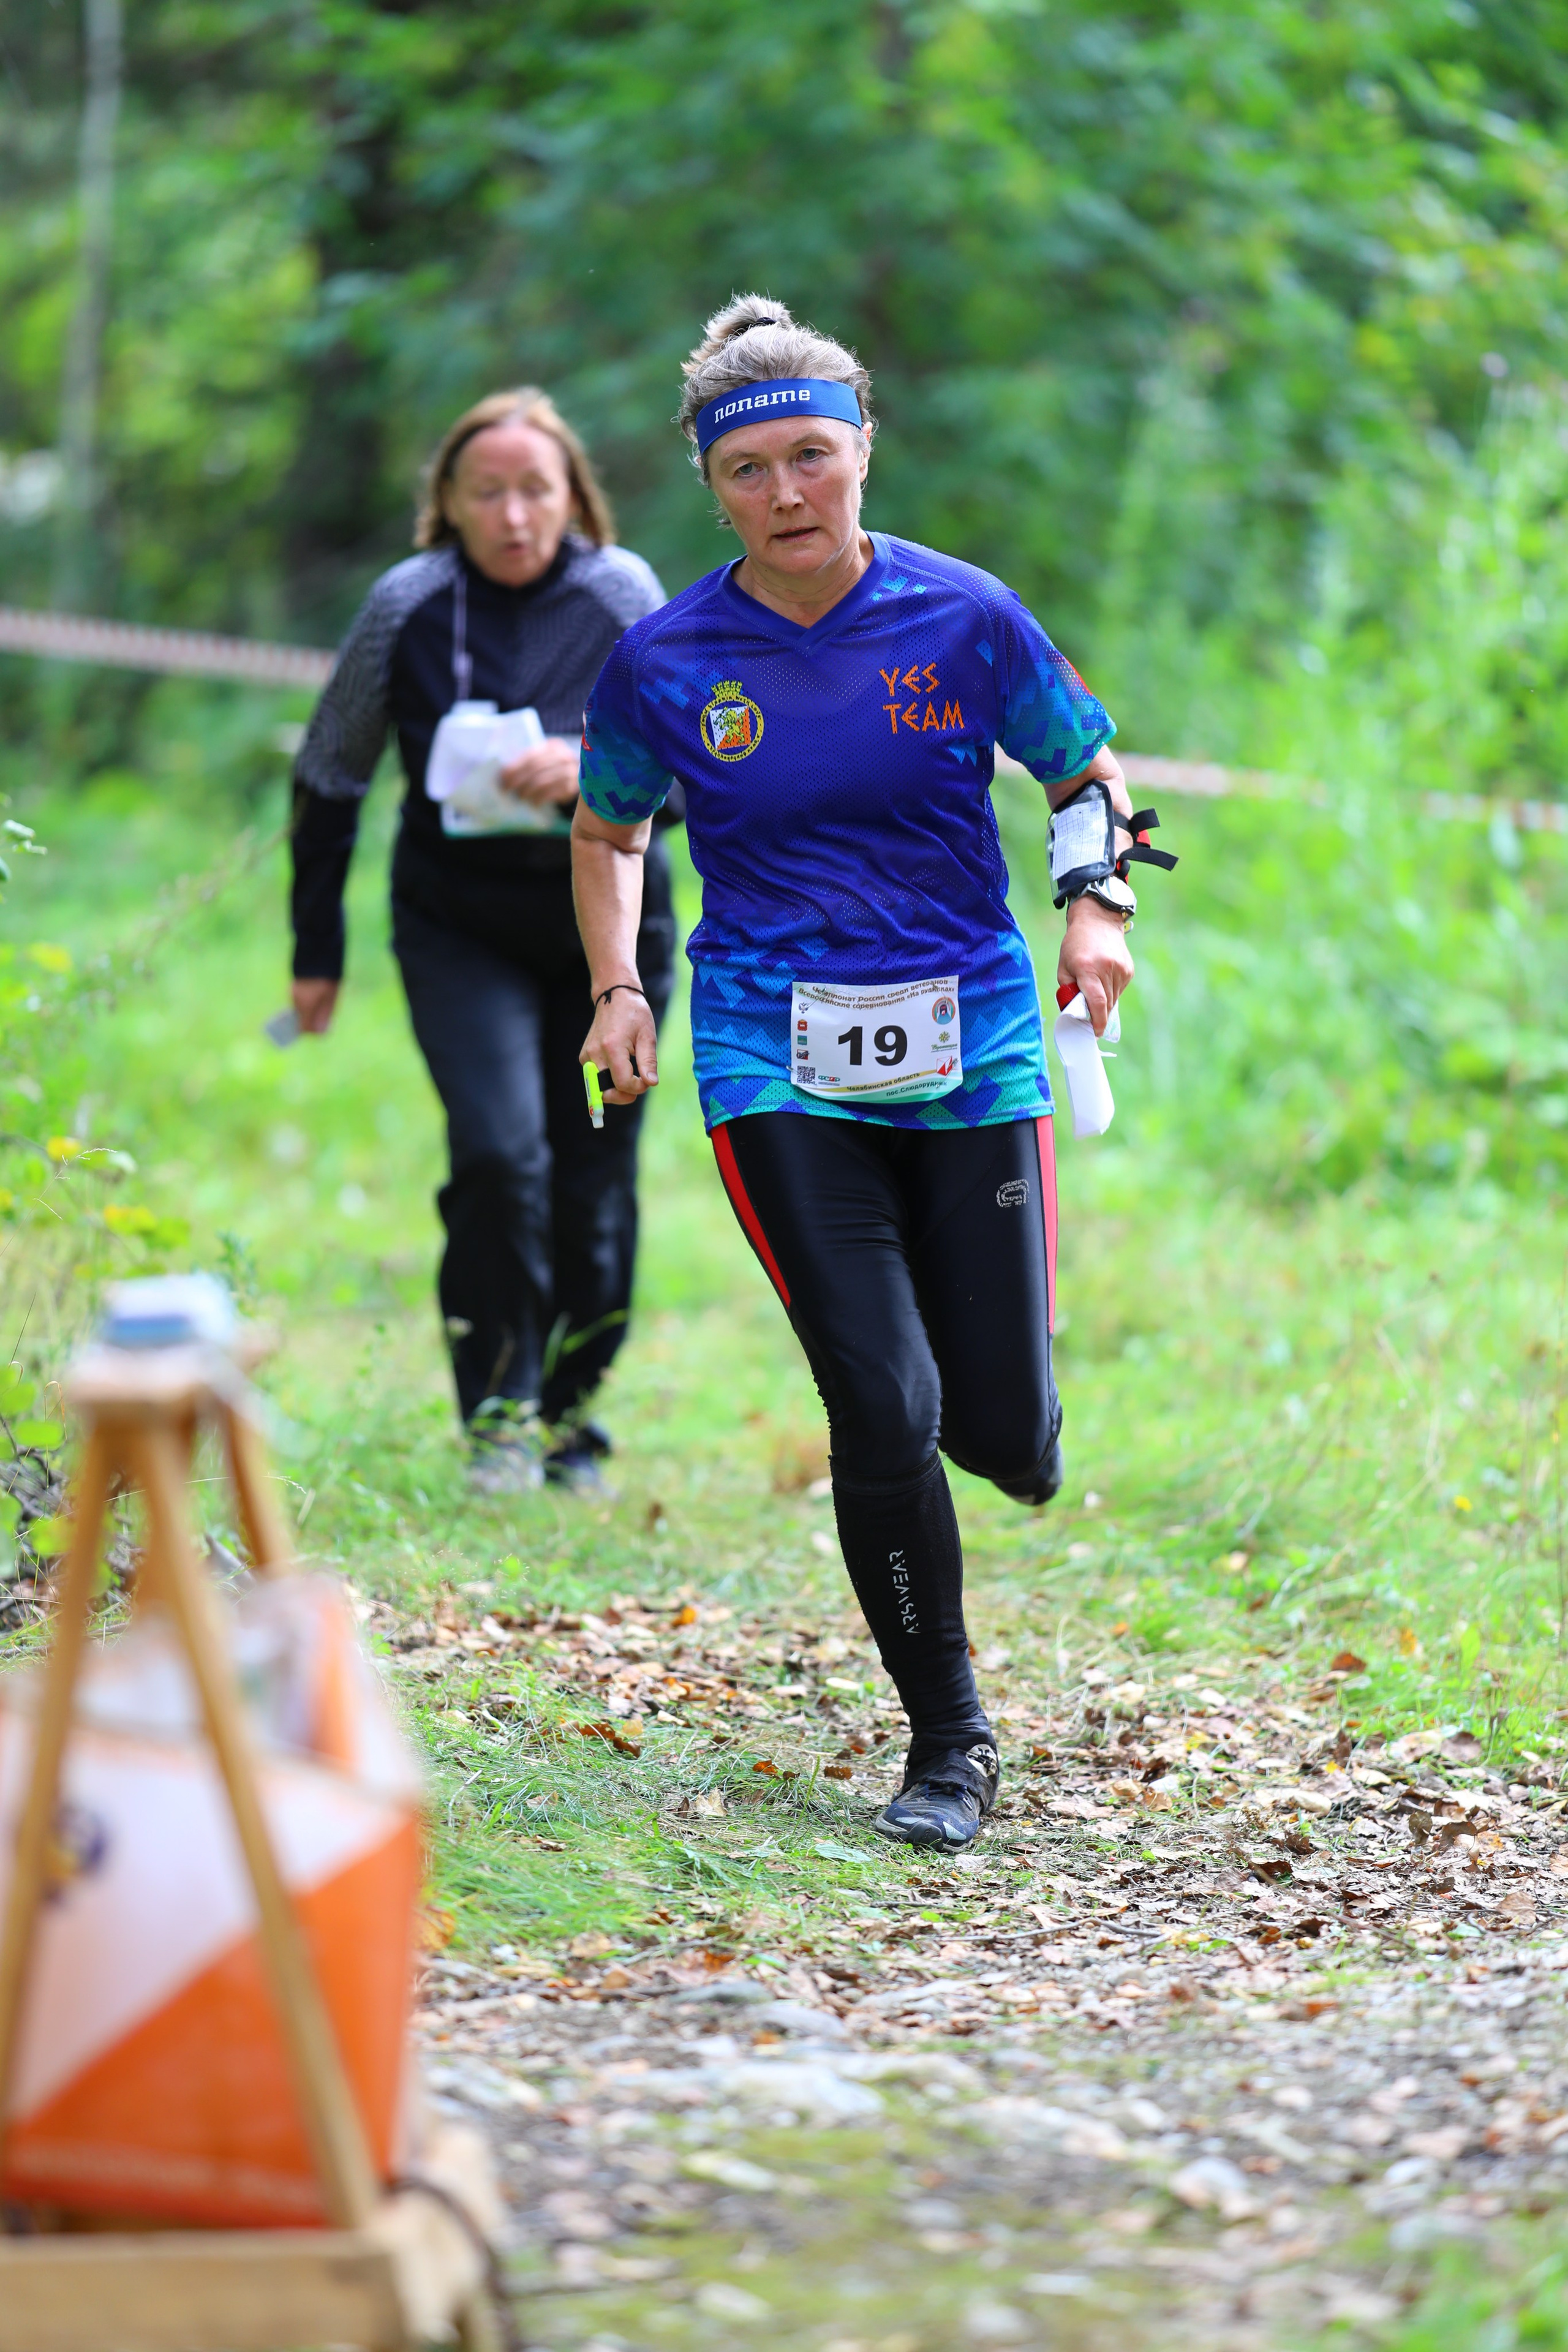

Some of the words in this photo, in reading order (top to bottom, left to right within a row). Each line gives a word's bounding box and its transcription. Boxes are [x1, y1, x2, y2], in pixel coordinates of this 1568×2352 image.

[715, 389, 810, 424] noname
[879, 662, 940, 696] YES
[883, 699, 965, 734] TEAM
[799, 987, 850, 1008] Всероссийские
[853, 996, 905, 1009] соревнования
[888, 987, 909, 999] среди
[911, 979, 948, 991] ветеранов
[838, 1025, 908, 1066] 19
[847, 1080, 892, 1091] Челябинская
[894, 1072, 920, 1084] область
